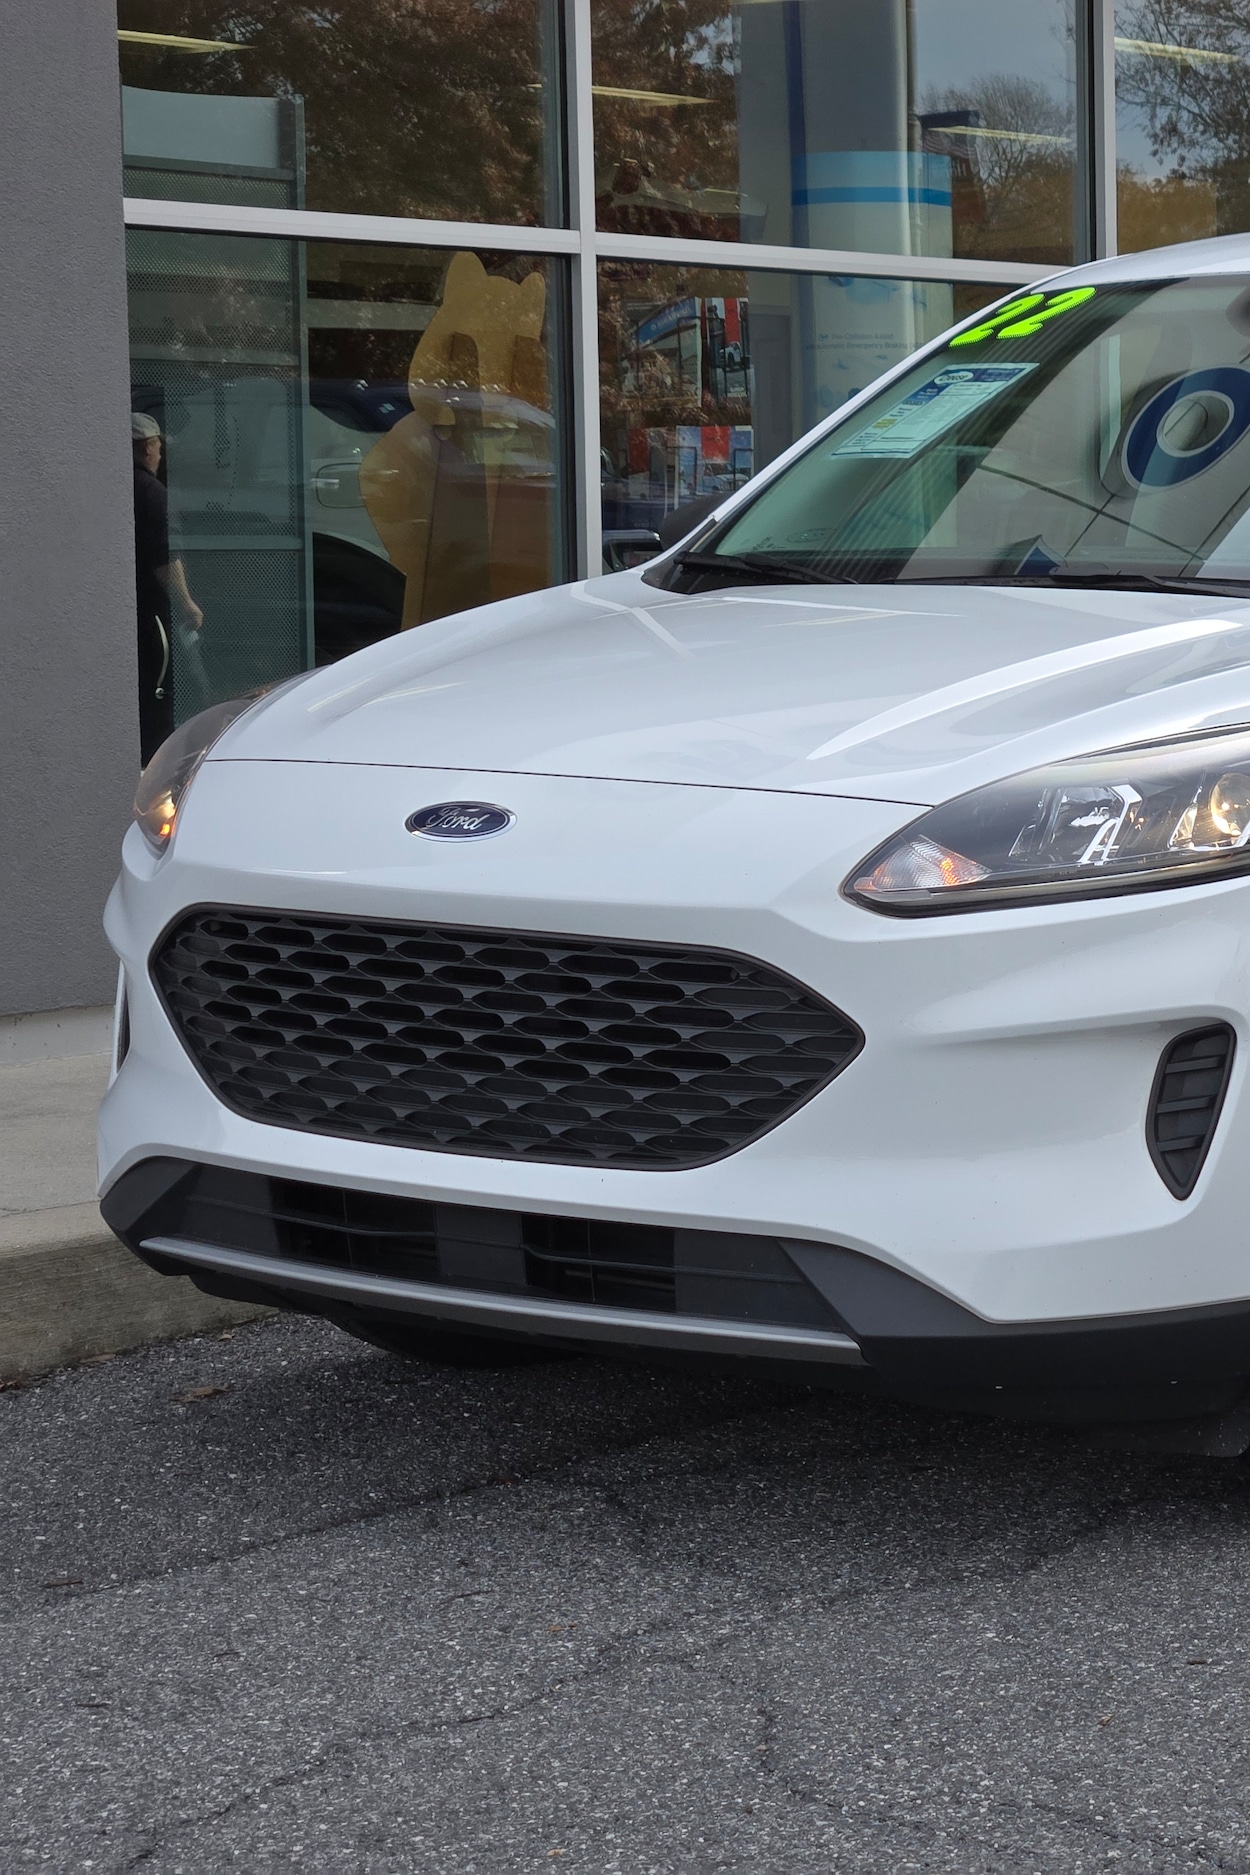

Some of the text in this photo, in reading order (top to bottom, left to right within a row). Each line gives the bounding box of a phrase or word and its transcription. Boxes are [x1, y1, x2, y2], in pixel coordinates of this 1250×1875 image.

[949, 287, 1097, 347] 22
[846, 342, 883, 351] Emergency
[425, 806, 491, 831] Ford
